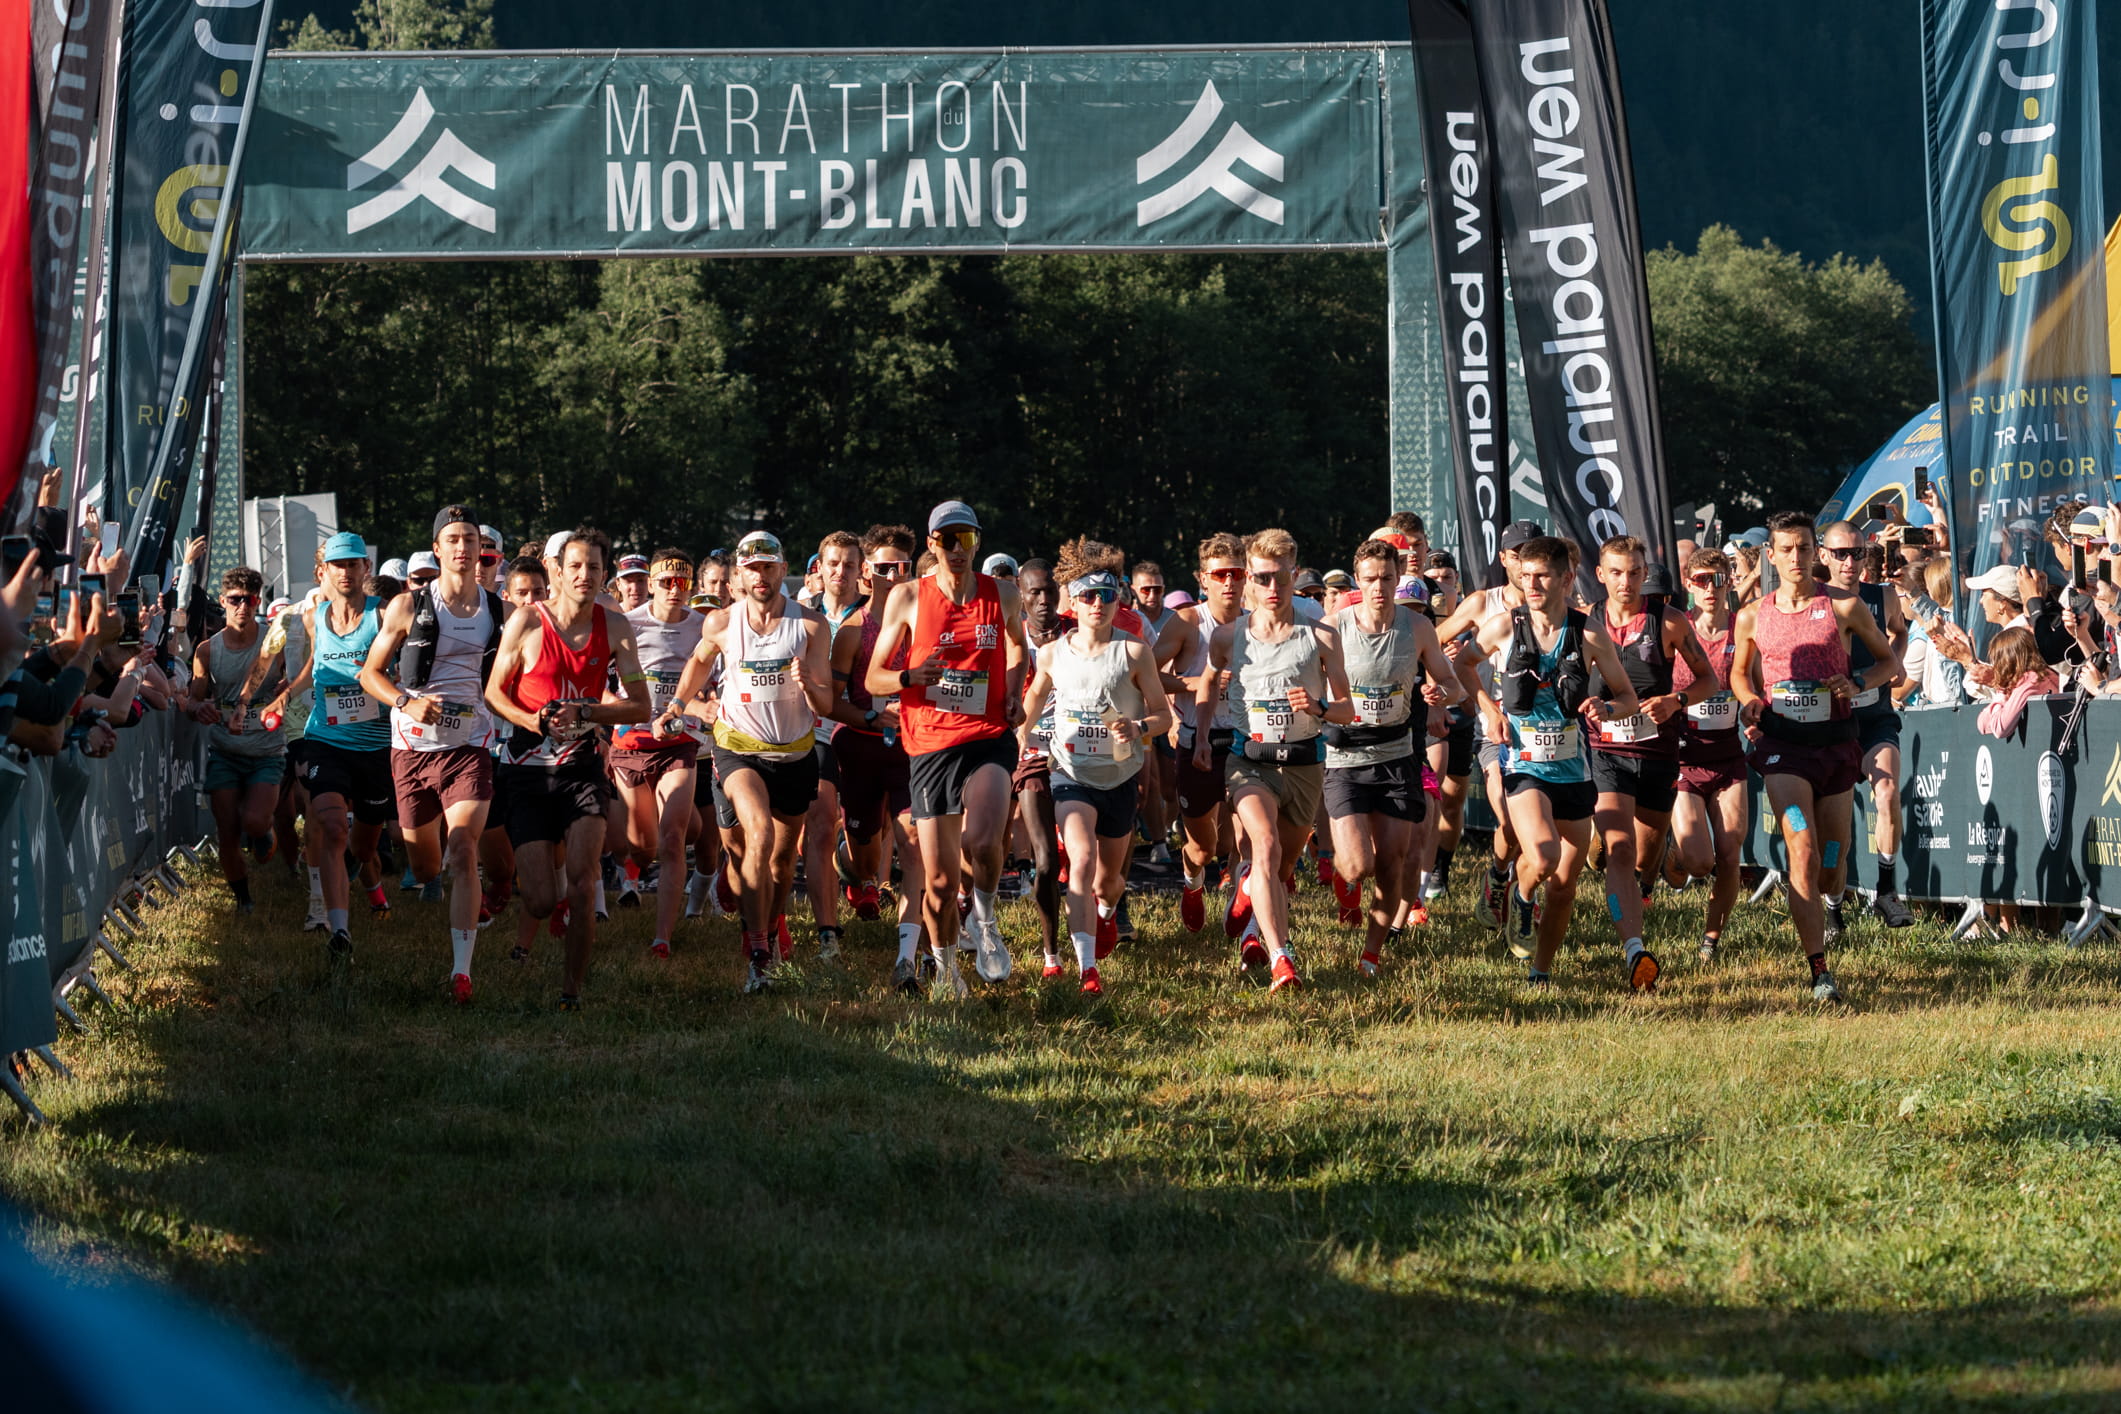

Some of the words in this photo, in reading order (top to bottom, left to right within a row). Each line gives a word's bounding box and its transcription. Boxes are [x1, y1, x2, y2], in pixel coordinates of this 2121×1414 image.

[606, 80, 1027, 155] MARATHON
[944, 108, 964, 126] du
[606, 156, 1028, 232] MONT-BLANC
[1970, 386, 2089, 415] RUNNING
[1993, 423, 2068, 449] TRAIL
[1970, 457, 2096, 487] OUTDOOR
[751, 674, 785, 687] 5086
[655, 683, 677, 695] 500
[941, 683, 974, 697] 5010
[338, 697, 366, 709] 5013
[1362, 699, 1393, 711] 5004
[1785, 695, 1818, 707] 5006
[1700, 704, 1729, 715] 5089
[1267, 713, 1295, 726] 5011
[1078, 726, 1108, 739] 5019
[1535, 734, 1566, 746] 5012
[1976, 821, 2006, 850] Région
